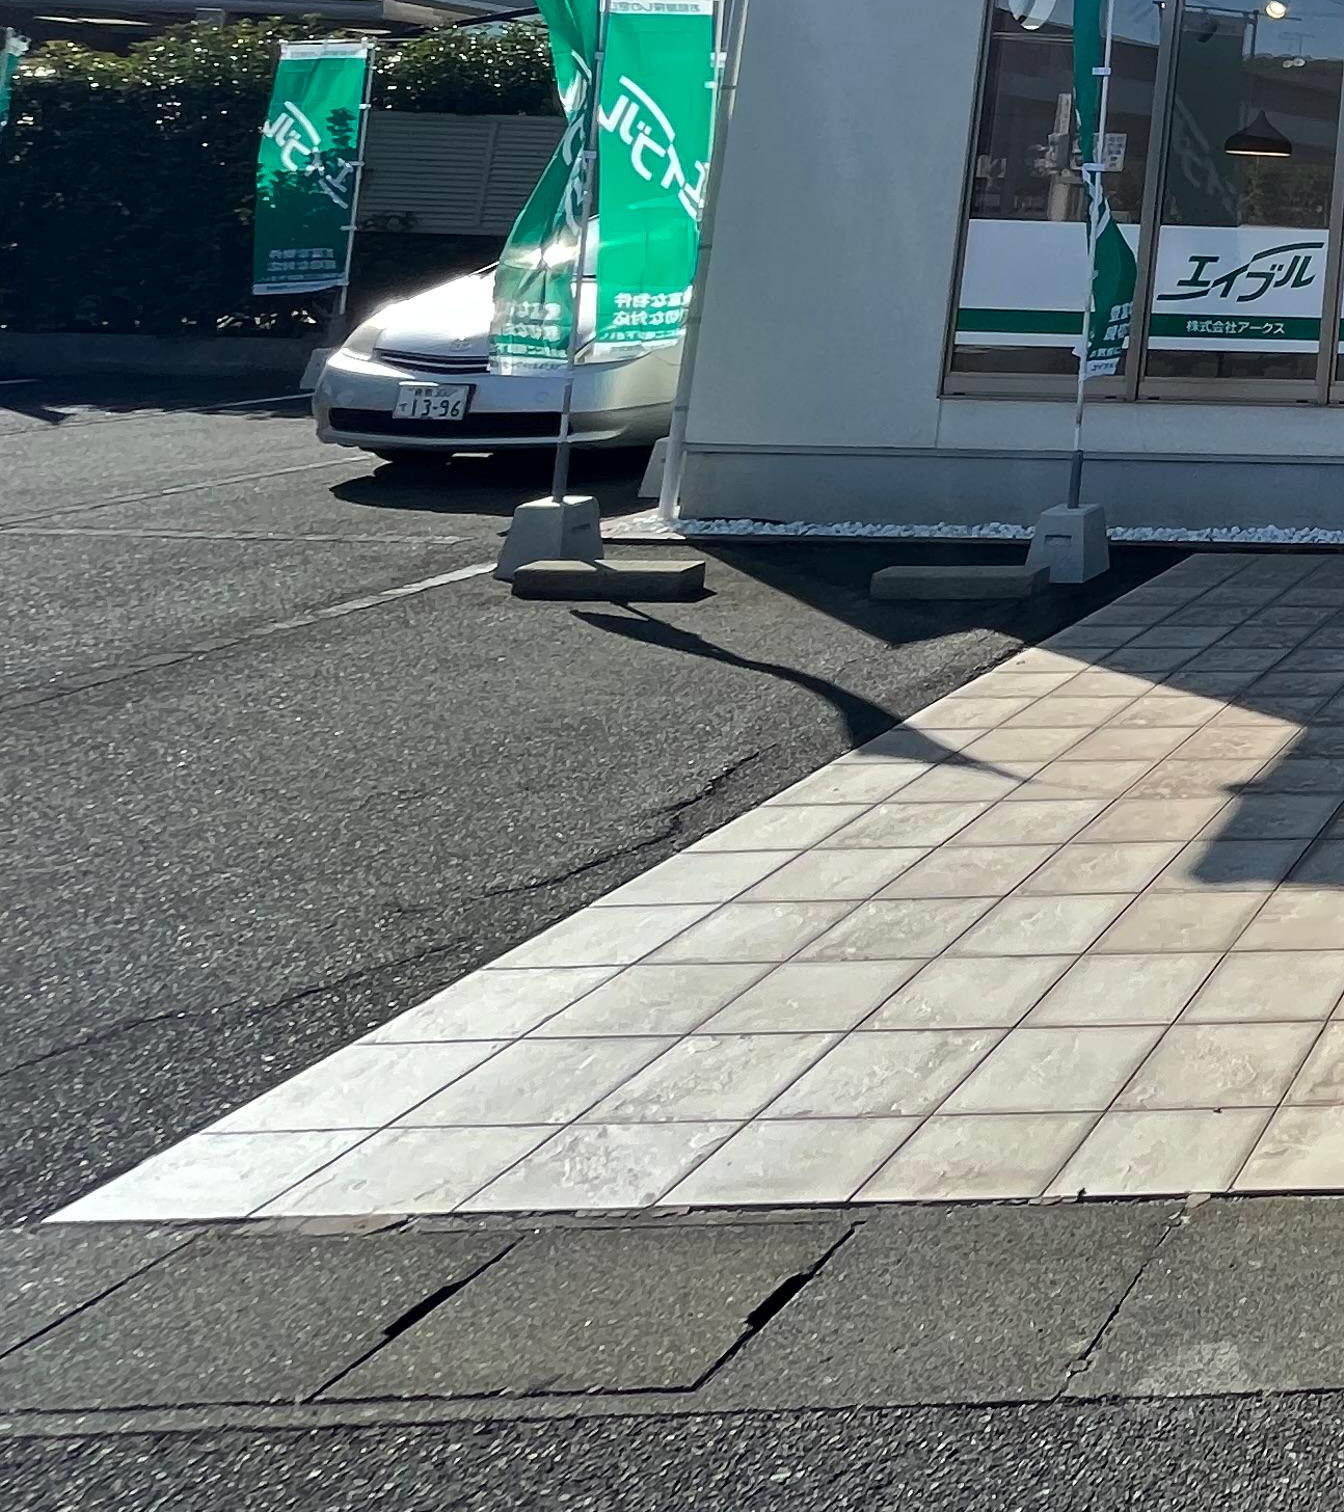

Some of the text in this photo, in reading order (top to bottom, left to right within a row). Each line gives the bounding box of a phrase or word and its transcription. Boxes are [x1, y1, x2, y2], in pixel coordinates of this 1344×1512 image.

[1156, 242, 1324, 303] エイブル
[1186, 320, 1285, 334] 株式会社アークス
[411, 399, 461, 417] 13-96
